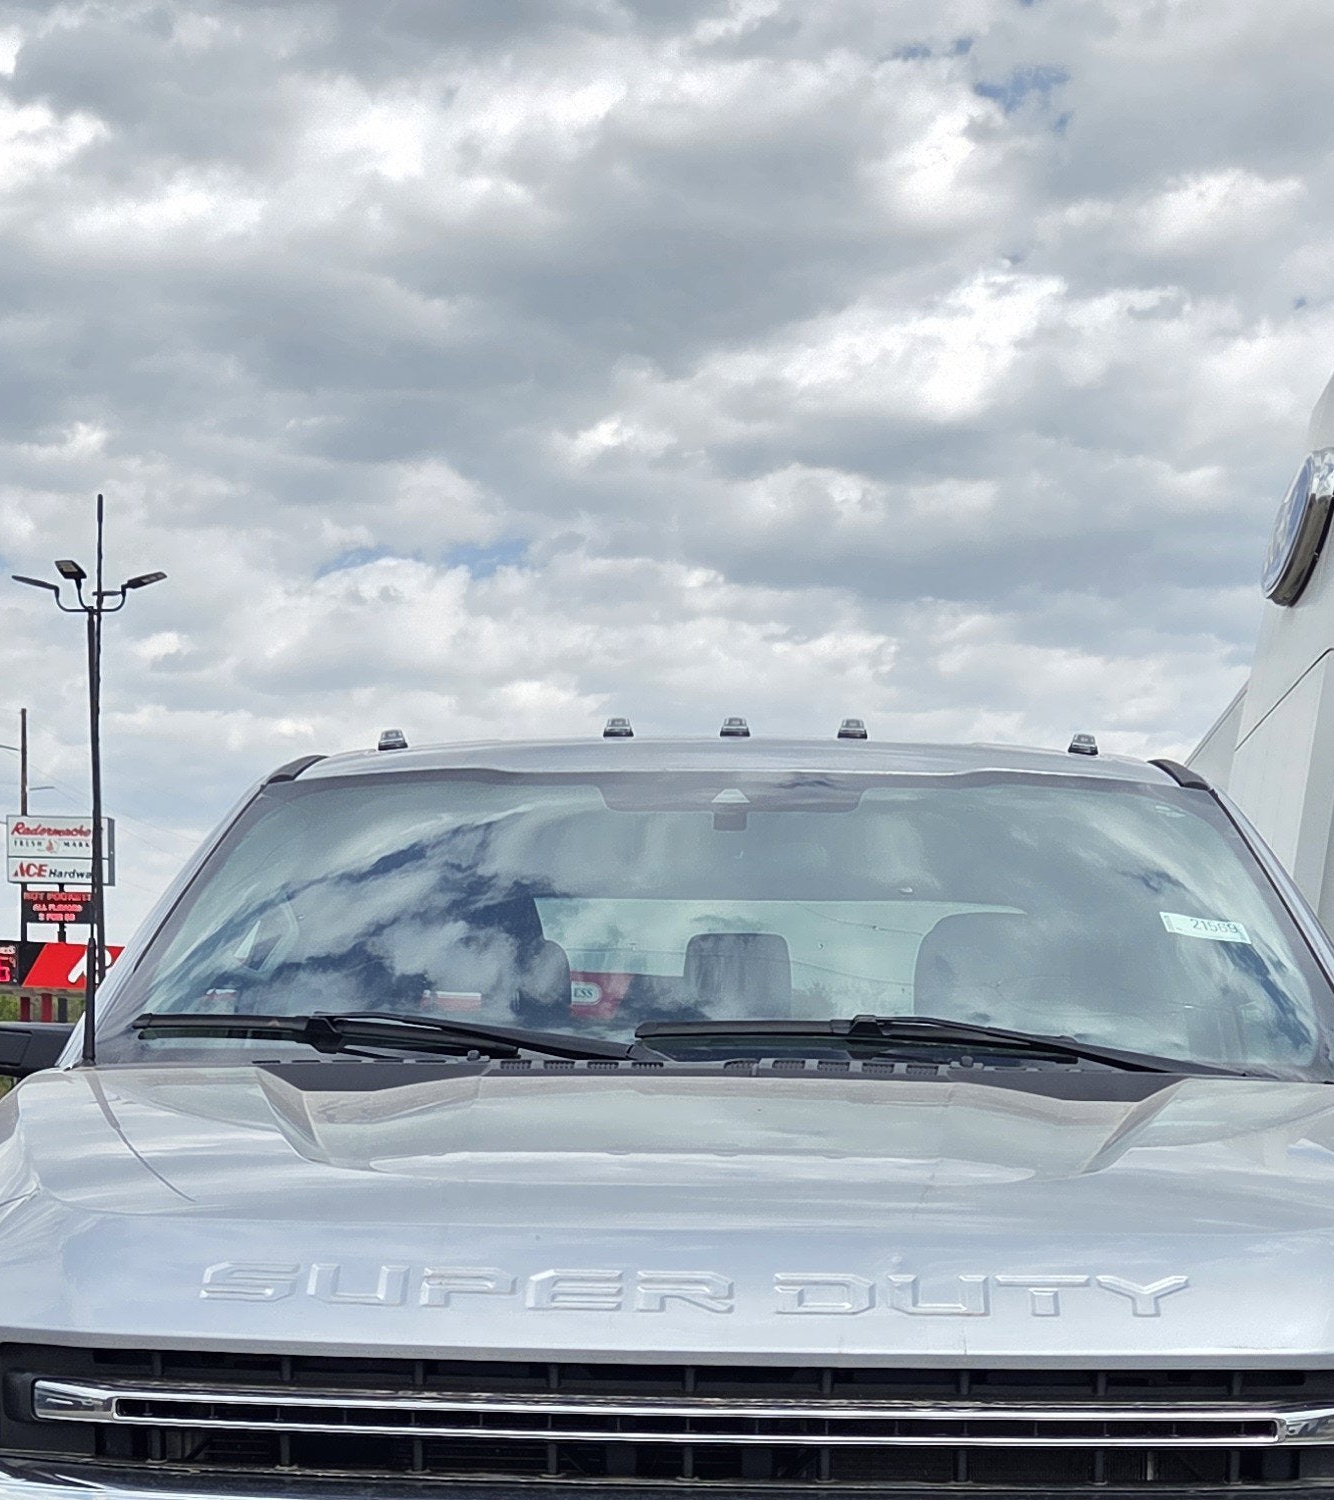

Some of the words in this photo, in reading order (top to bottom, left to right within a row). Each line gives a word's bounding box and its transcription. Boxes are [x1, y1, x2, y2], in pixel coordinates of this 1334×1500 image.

[11, 822, 91, 837] Radermache
[13, 861, 47, 878] ACE
[48, 868, 92, 879] Hardwa
[574, 988, 594, 998] ESS
[198, 1260, 737, 1315] SUPER
[773, 1271, 1191, 1318] DUTY
